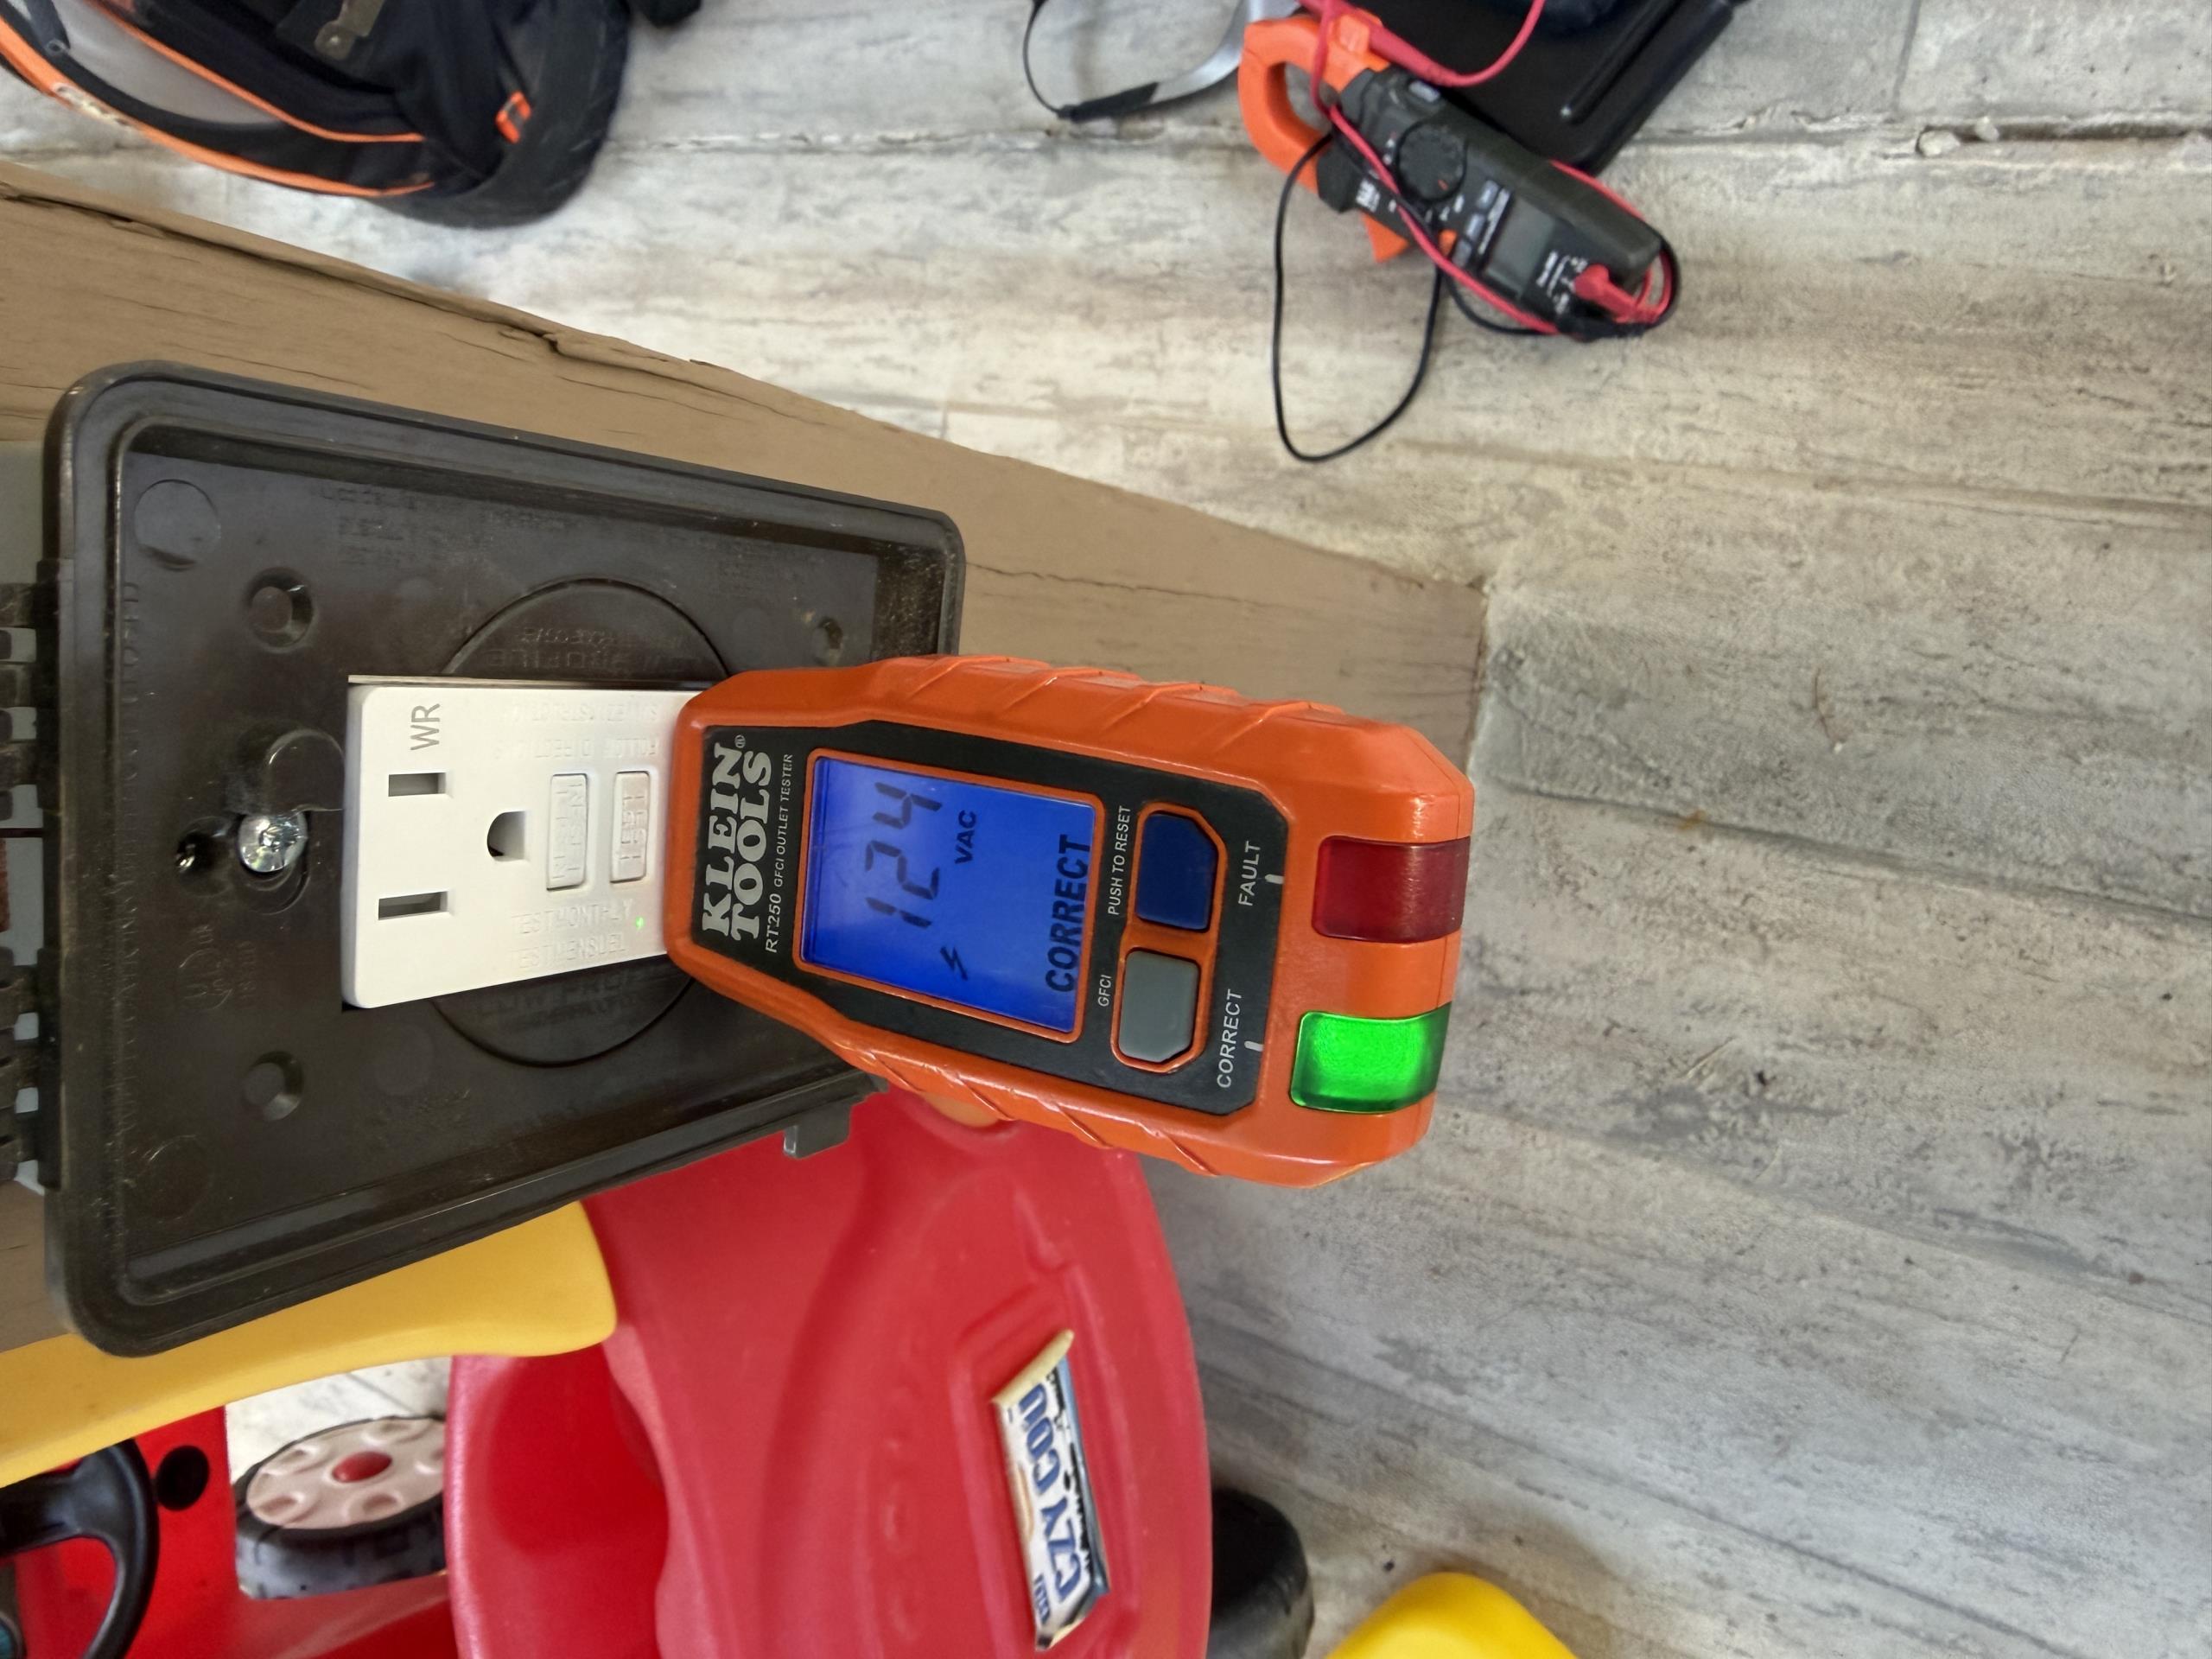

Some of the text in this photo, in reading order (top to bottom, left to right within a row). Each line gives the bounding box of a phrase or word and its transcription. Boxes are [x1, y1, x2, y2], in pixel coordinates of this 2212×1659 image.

[410, 702, 441, 751] WR
[701, 743, 743, 936] KLEIN
[730, 750, 773, 941] TOOLS
[765, 753, 793, 953] RT250 GFCI OUTLET TESTER
[863, 782, 944, 929] 124
[954, 810, 976, 864] VAC
[1108, 805, 1130, 915] PUSH TO RESET
[1237, 841, 1262, 906] FAULT
[1045, 834, 1091, 992] CORRECT
[1097, 974, 1112, 1007] GFCI
[1216, 988, 1243, 1089] CORRECT
[1039, 1497, 1082, 1600] CZY
